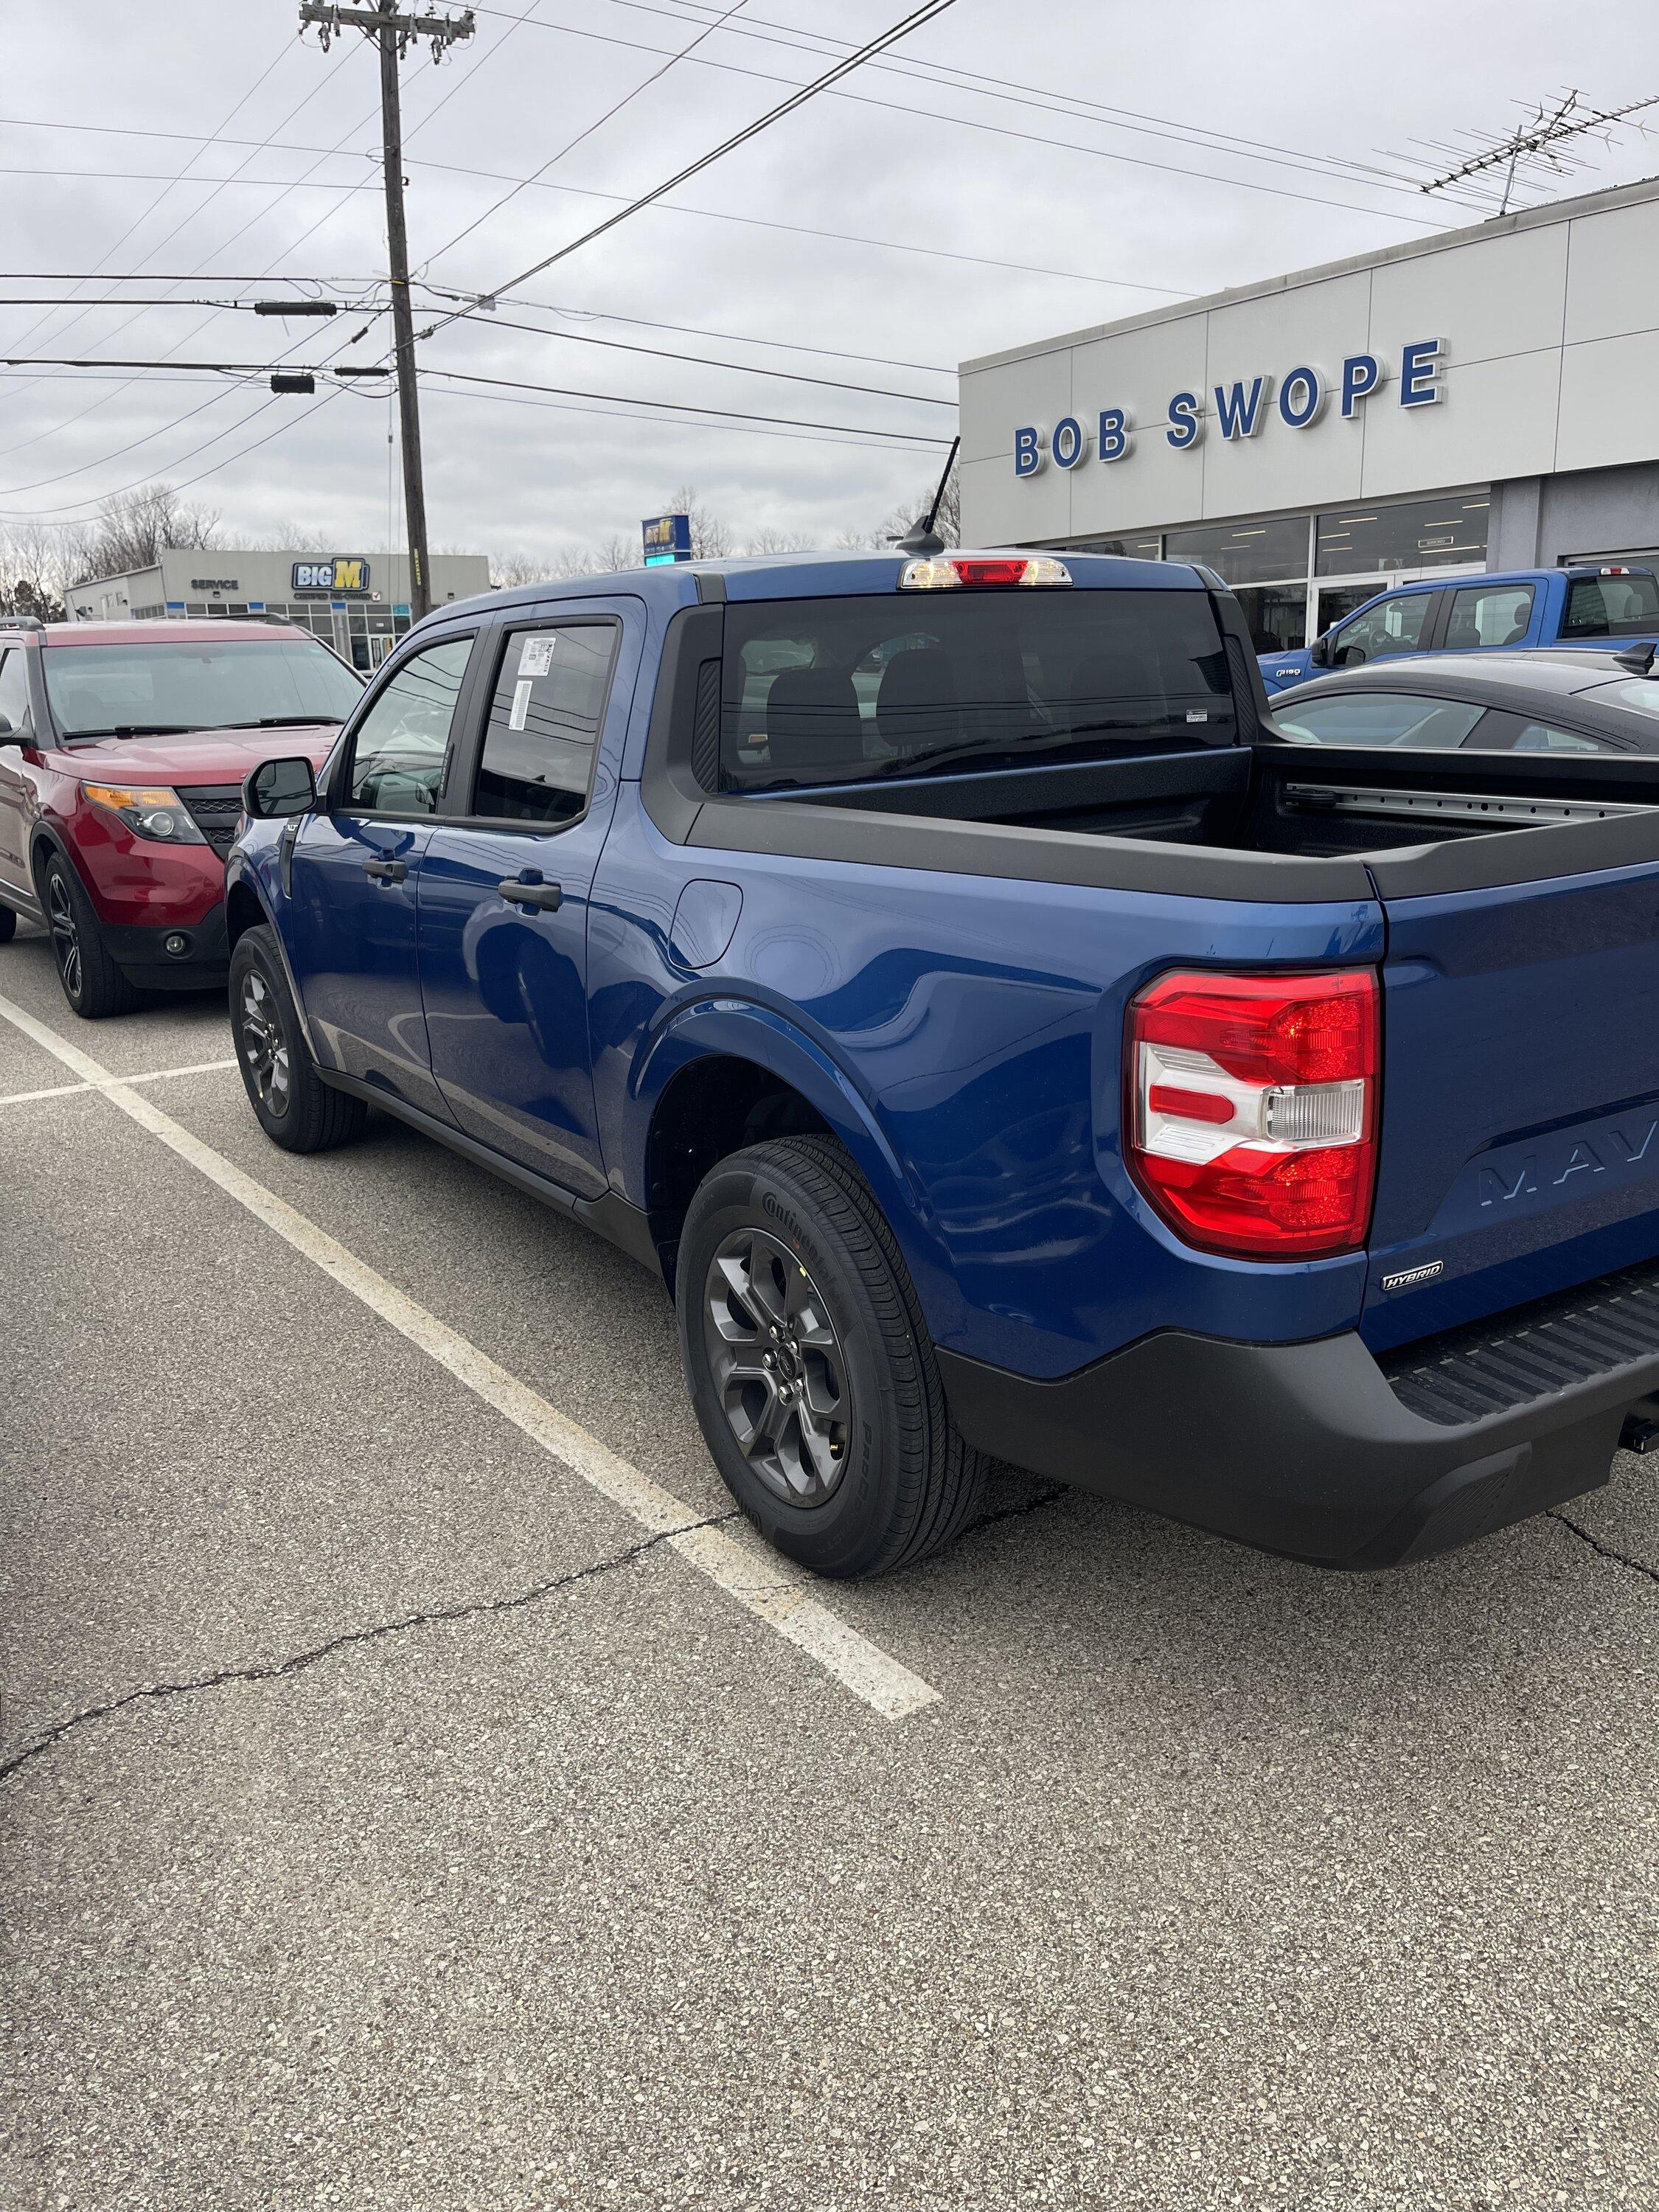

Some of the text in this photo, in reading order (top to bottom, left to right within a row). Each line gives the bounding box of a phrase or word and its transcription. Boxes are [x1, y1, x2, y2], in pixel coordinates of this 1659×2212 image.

[1014, 338, 1445, 478] BOB SWOPE
[191, 579, 239, 590] SERVICE
[297, 560, 362, 588] BIG M
[762, 1192, 838, 1287] Continental
[1386, 1265, 1440, 1288] HYBRID
